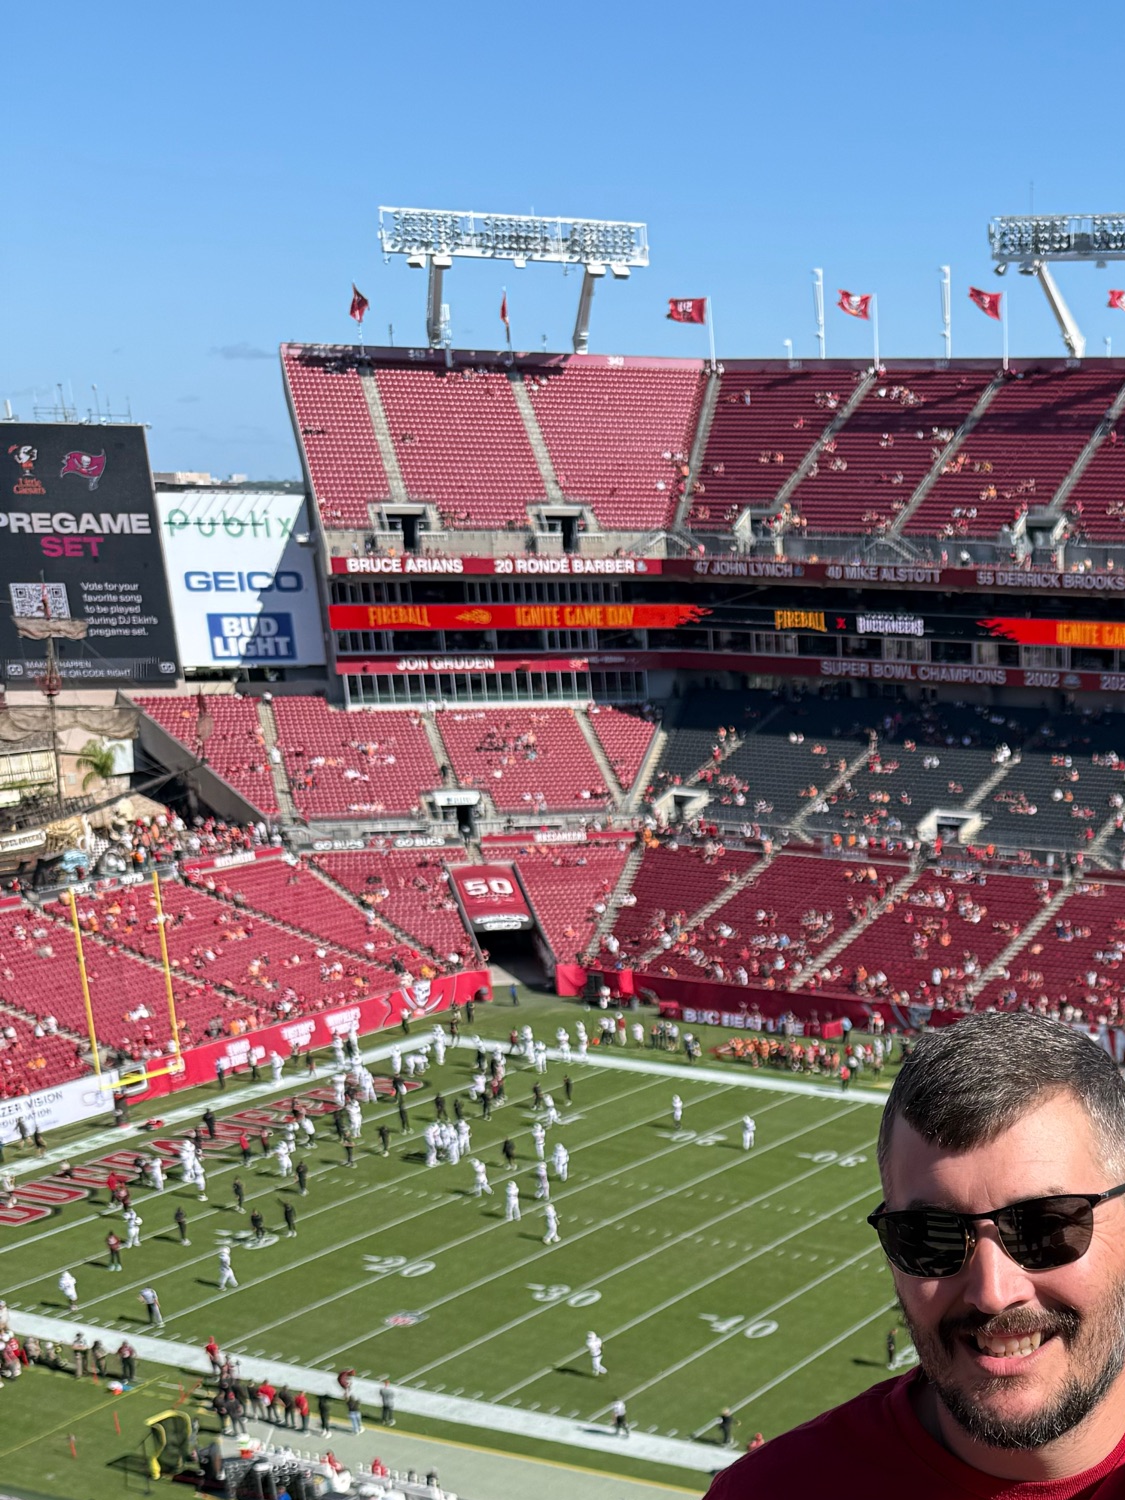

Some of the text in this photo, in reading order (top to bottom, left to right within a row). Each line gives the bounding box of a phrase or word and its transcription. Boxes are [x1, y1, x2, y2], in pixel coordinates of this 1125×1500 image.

[40, 536, 104, 558] SET
[346, 558, 464, 574] BRUCE ARIANS
[494, 559, 513, 574] 20
[572, 558, 636, 574] BARBER
[710, 562, 748, 577] JOHN
[749, 563, 793, 578] LYNCH
[843, 566, 879, 581] MIKE
[880, 567, 942, 583] ALSTOTT
[184, 570, 304, 592] GEICO
[976, 570, 994, 586] 55
[996, 571, 1060, 588] DERRICK
[80, 582, 140, 595] Vote for your
[82, 593, 143, 606] favorite song
[95, 604, 108, 614] be
[109, 604, 141, 616] played
[368, 606, 635, 627] FIREBALL IGNITE GAME DAY
[117, 616, 130, 626] DJ
[221, 615, 278, 638] BUD
[774, 609, 828, 633] FIREBALL
[88, 627, 129, 639] pregame
[1056, 622, 1100, 645] IGNITE
[213, 636, 291, 658] LIGHT
[396, 656, 495, 671] JON GRUDEN
[820, 660, 1007, 684] SUPER BOWL CHAMPIONS
[1024, 671, 1060, 688] 2002
[462, 876, 514, 896] 50
